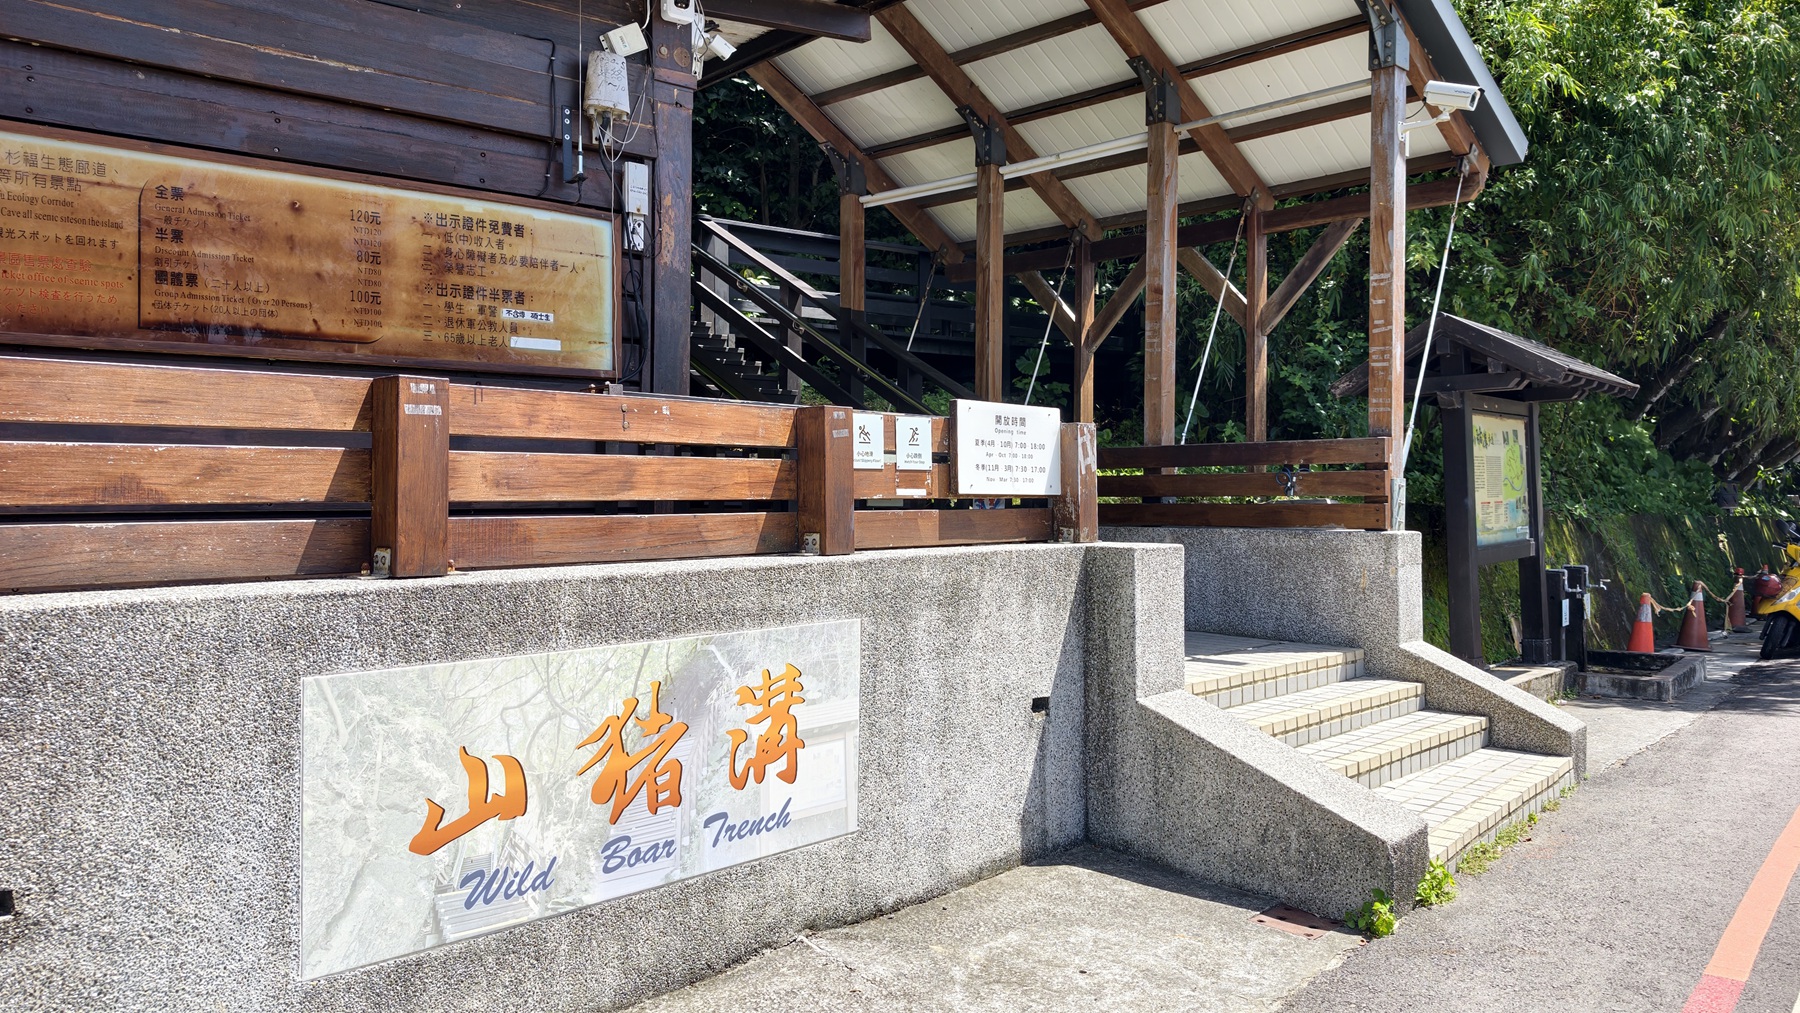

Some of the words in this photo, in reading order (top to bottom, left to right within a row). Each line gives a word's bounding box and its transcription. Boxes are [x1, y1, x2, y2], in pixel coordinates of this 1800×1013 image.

[7, 191, 39, 205] Ecology
[41, 195, 74, 208] Corridor
[155, 184, 184, 201] 全票
[1, 207, 21, 217] Cave
[22, 209, 33, 219] all
[34, 211, 58, 222] scenic
[88, 217, 101, 227] the
[101, 219, 124, 230] island
[154, 203, 185, 214] General
[187, 207, 227, 218] Admission
[228, 212, 251, 222] Ticket
[350, 209, 382, 226] 120元
[154, 215, 209, 229] 一般チケット
[0, 226, 119, 250] 光スポットを回れます
[155, 227, 184, 244] 半票
[353, 226, 382, 236] NTD120
[353, 237, 382, 248] NTD120
[154, 246, 189, 257] Discount
[191, 250, 231, 261] Admission
[232, 253, 255, 264] Ticket
[356, 250, 382, 265] 80元
[154, 257, 209, 270] 割引チケット
[357, 267, 382, 276] NTD80
[0, 270, 25, 280] icket
[27, 272, 57, 283] office
[57, 275, 69, 284] of
[69, 276, 98, 287] scenic
[100, 280, 124, 290] spots
[357, 278, 382, 287] NTD80
[154, 289, 179, 299] Group
[180, 291, 221, 302] Admission
[221, 294, 245, 304] Ticket
[271, 298, 280, 307] 20
[280, 300, 312, 310] Persons)
[350, 289, 382, 305] 100元
[353, 307, 382, 316] NTD100
[353, 318, 382, 328] NTD100
[995, 414, 1026, 427] 開放時間
[994, 427, 1014, 436] Opening
[1015, 441, 1027, 449] 7:00
[1015, 465, 1028, 473] 7:30
[459, 855, 558, 911] Wild
[600, 835, 678, 875] Boar
[703, 797, 793, 848] Trench
